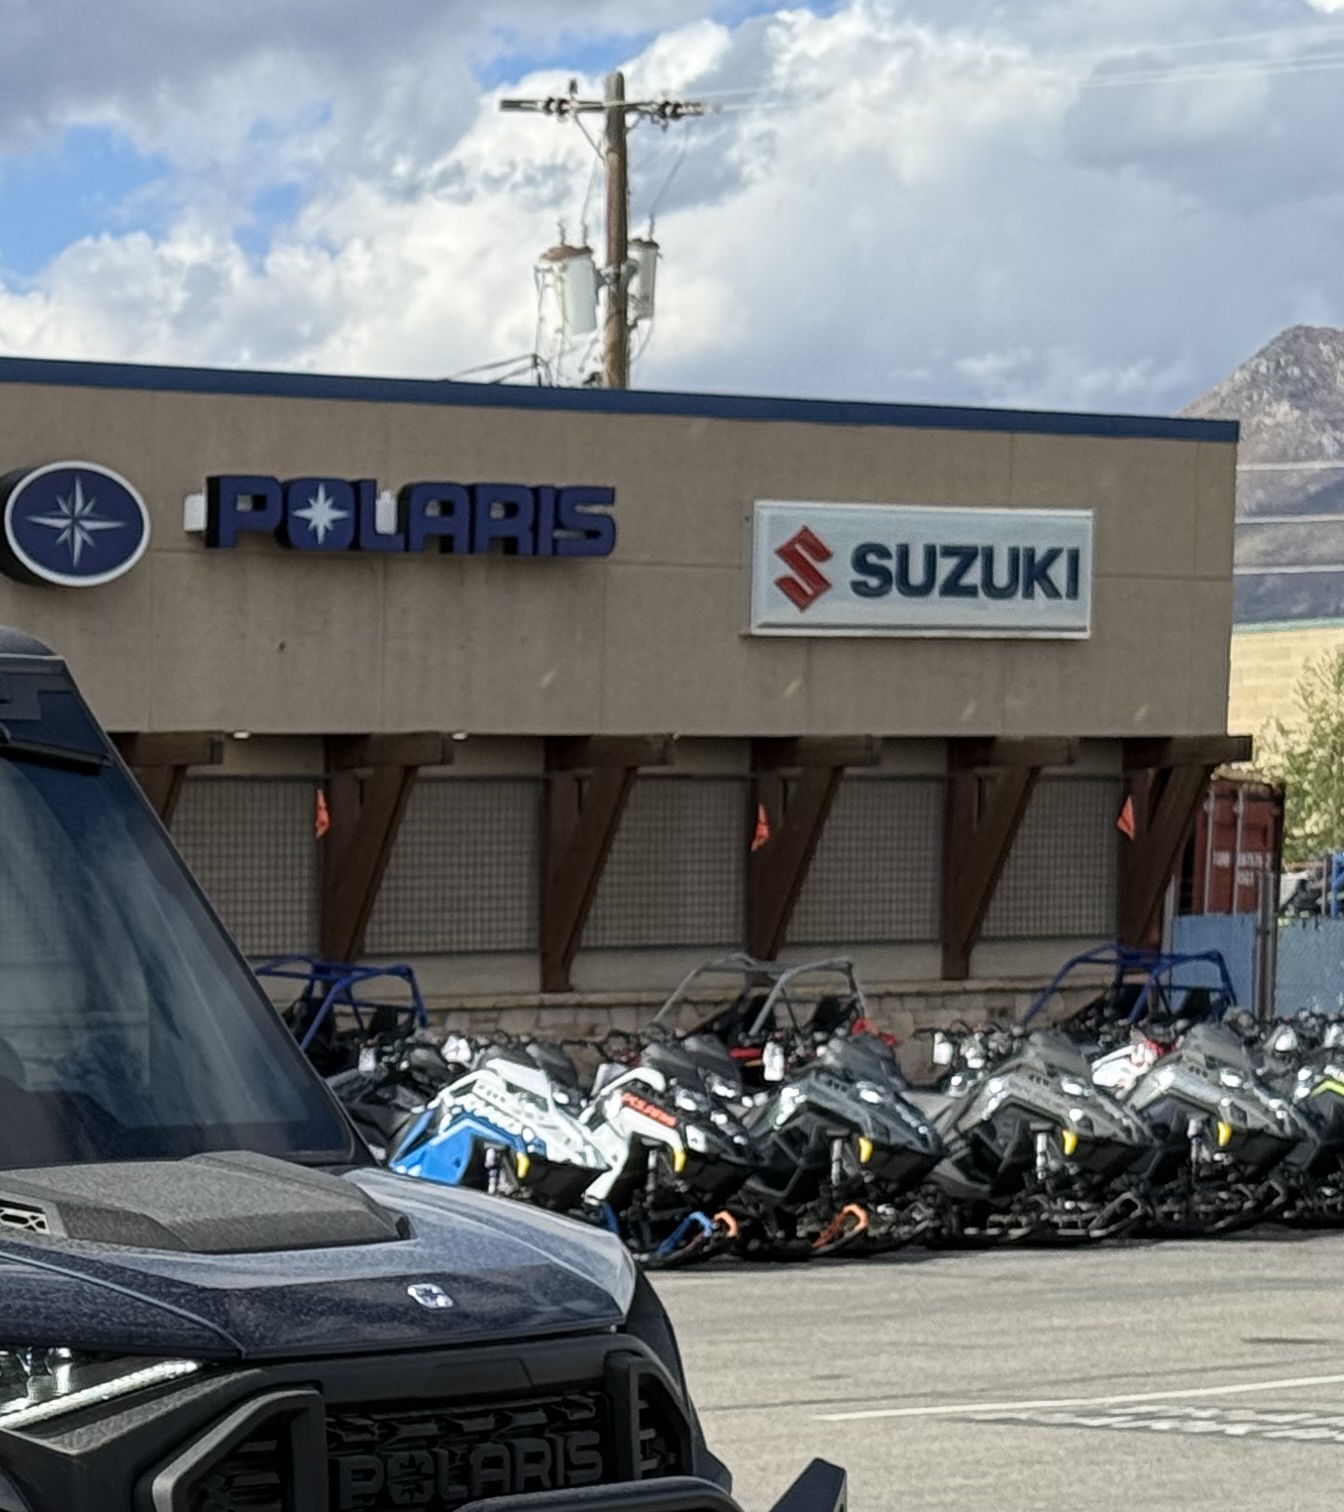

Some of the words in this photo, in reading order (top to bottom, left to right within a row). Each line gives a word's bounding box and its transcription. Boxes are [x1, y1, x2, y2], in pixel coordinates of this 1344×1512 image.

[206, 475, 616, 556] POLARIS
[850, 542, 1080, 599] SUZUKI
[338, 1430, 603, 1510] POLARIS
